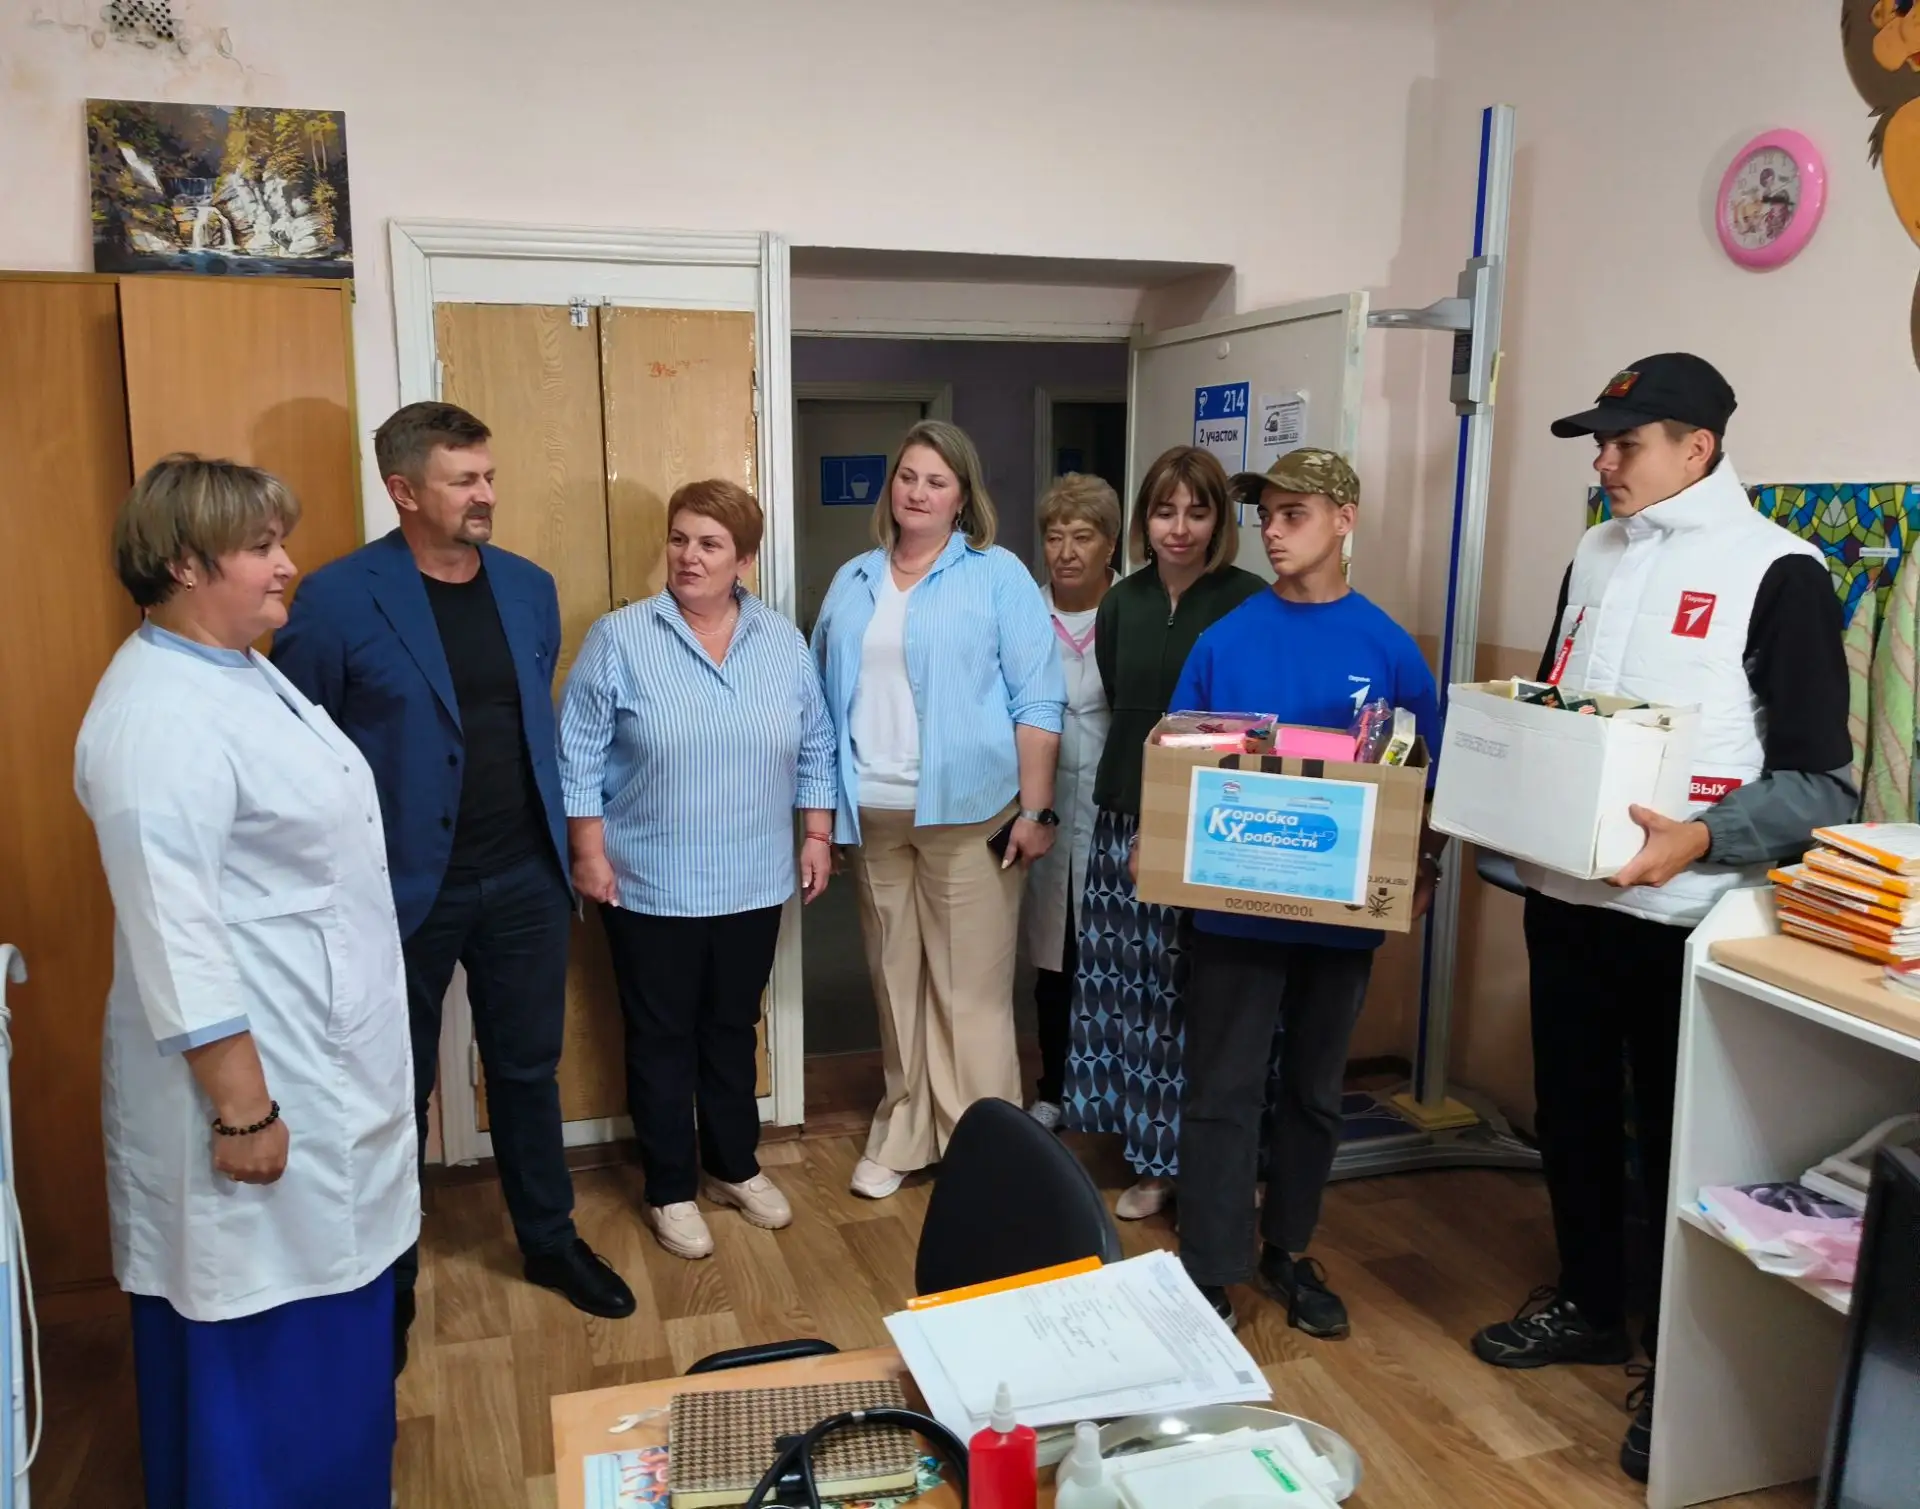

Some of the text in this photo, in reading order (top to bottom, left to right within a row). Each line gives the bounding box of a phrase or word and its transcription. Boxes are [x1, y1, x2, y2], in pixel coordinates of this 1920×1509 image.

[1223, 388, 1244, 412] 214
[1199, 428, 1238, 446] 2 участок
[1208, 807, 1299, 836] Коробка
[1224, 822, 1318, 849] Храбрости
[1225, 898, 1314, 917] 10000/200/20
